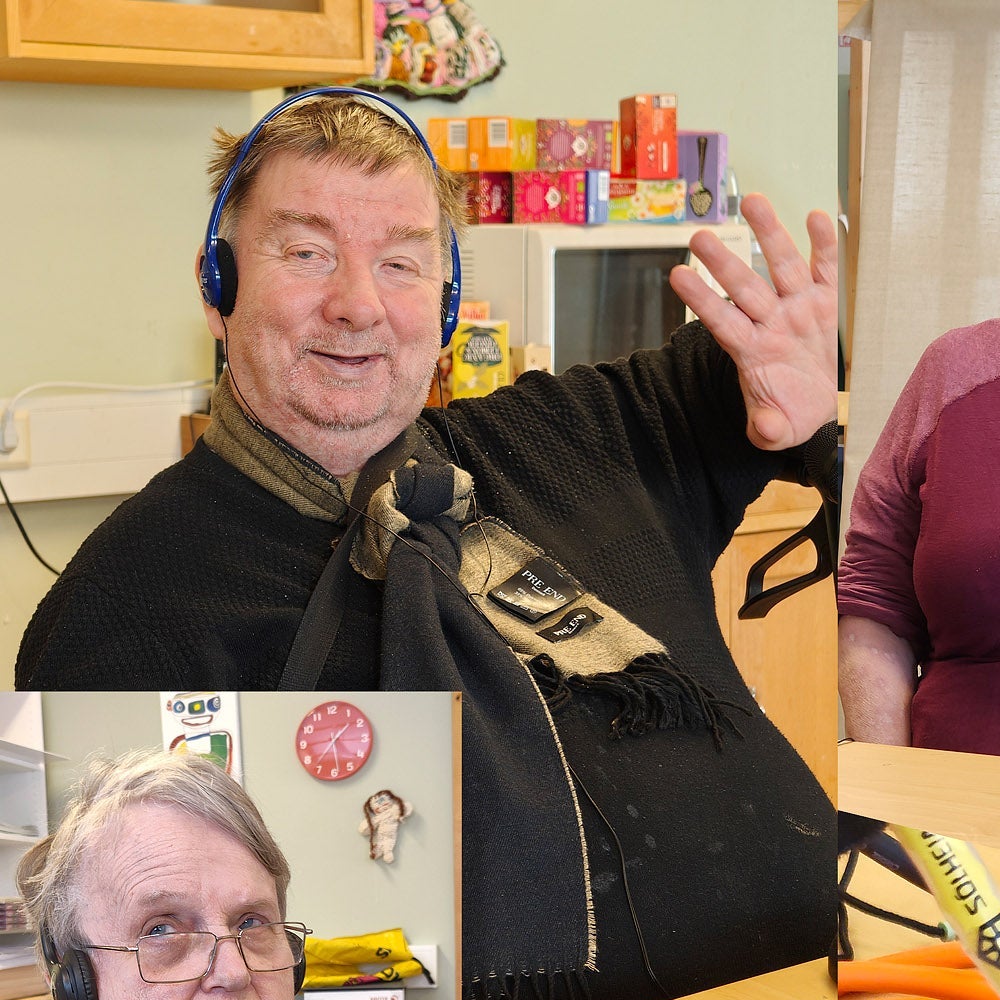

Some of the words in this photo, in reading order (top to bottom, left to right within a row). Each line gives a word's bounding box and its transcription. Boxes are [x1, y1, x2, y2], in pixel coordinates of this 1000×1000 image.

[522, 570, 544, 588] PRE
[543, 587, 566, 602] END
[553, 626, 572, 636] PRE
[570, 614, 586, 627] END
[327, 706, 337, 715] 12
[346, 709, 350, 717] 1
[313, 713, 321, 721] 11
[357, 719, 364, 727] 2
[304, 725, 313, 734] 10
[361, 734, 369, 742] 3
[300, 741, 307, 749] 9
[357, 750, 364, 758] 4
[304, 756, 311, 764] 8
[316, 766, 322, 774] 7
[346, 763, 353, 771] 5
[331, 769, 338, 777] 6
